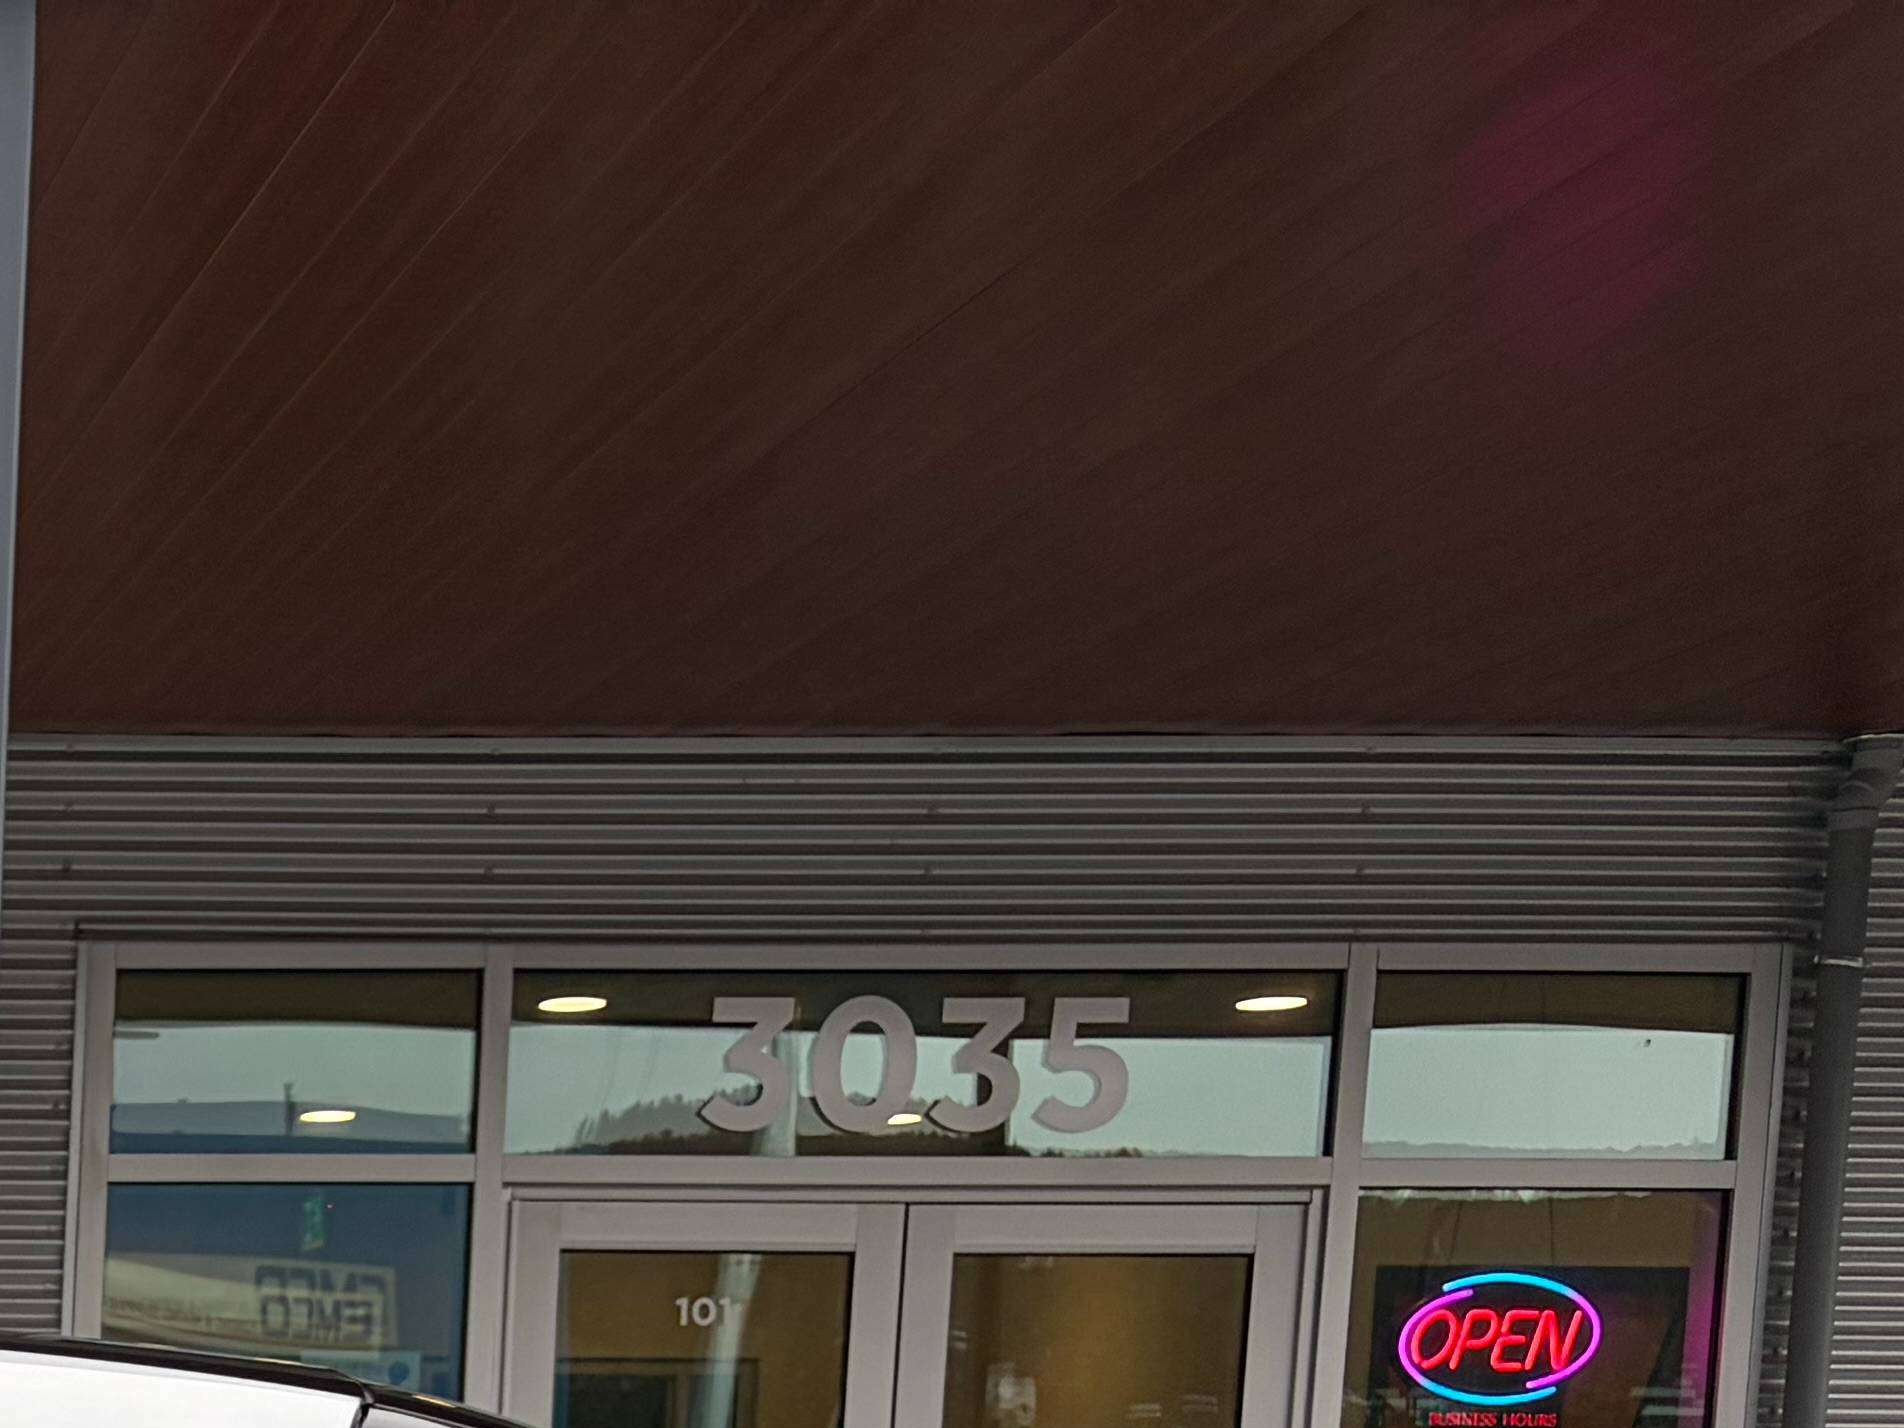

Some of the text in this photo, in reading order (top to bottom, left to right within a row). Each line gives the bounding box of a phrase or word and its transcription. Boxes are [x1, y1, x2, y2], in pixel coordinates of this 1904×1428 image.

[696, 994, 1130, 1133] 3035
[674, 1296, 732, 1327] 101
[1410, 1308, 1584, 1373] OPEN
[1428, 1411, 1558, 1428] BUSINESS HOURS
